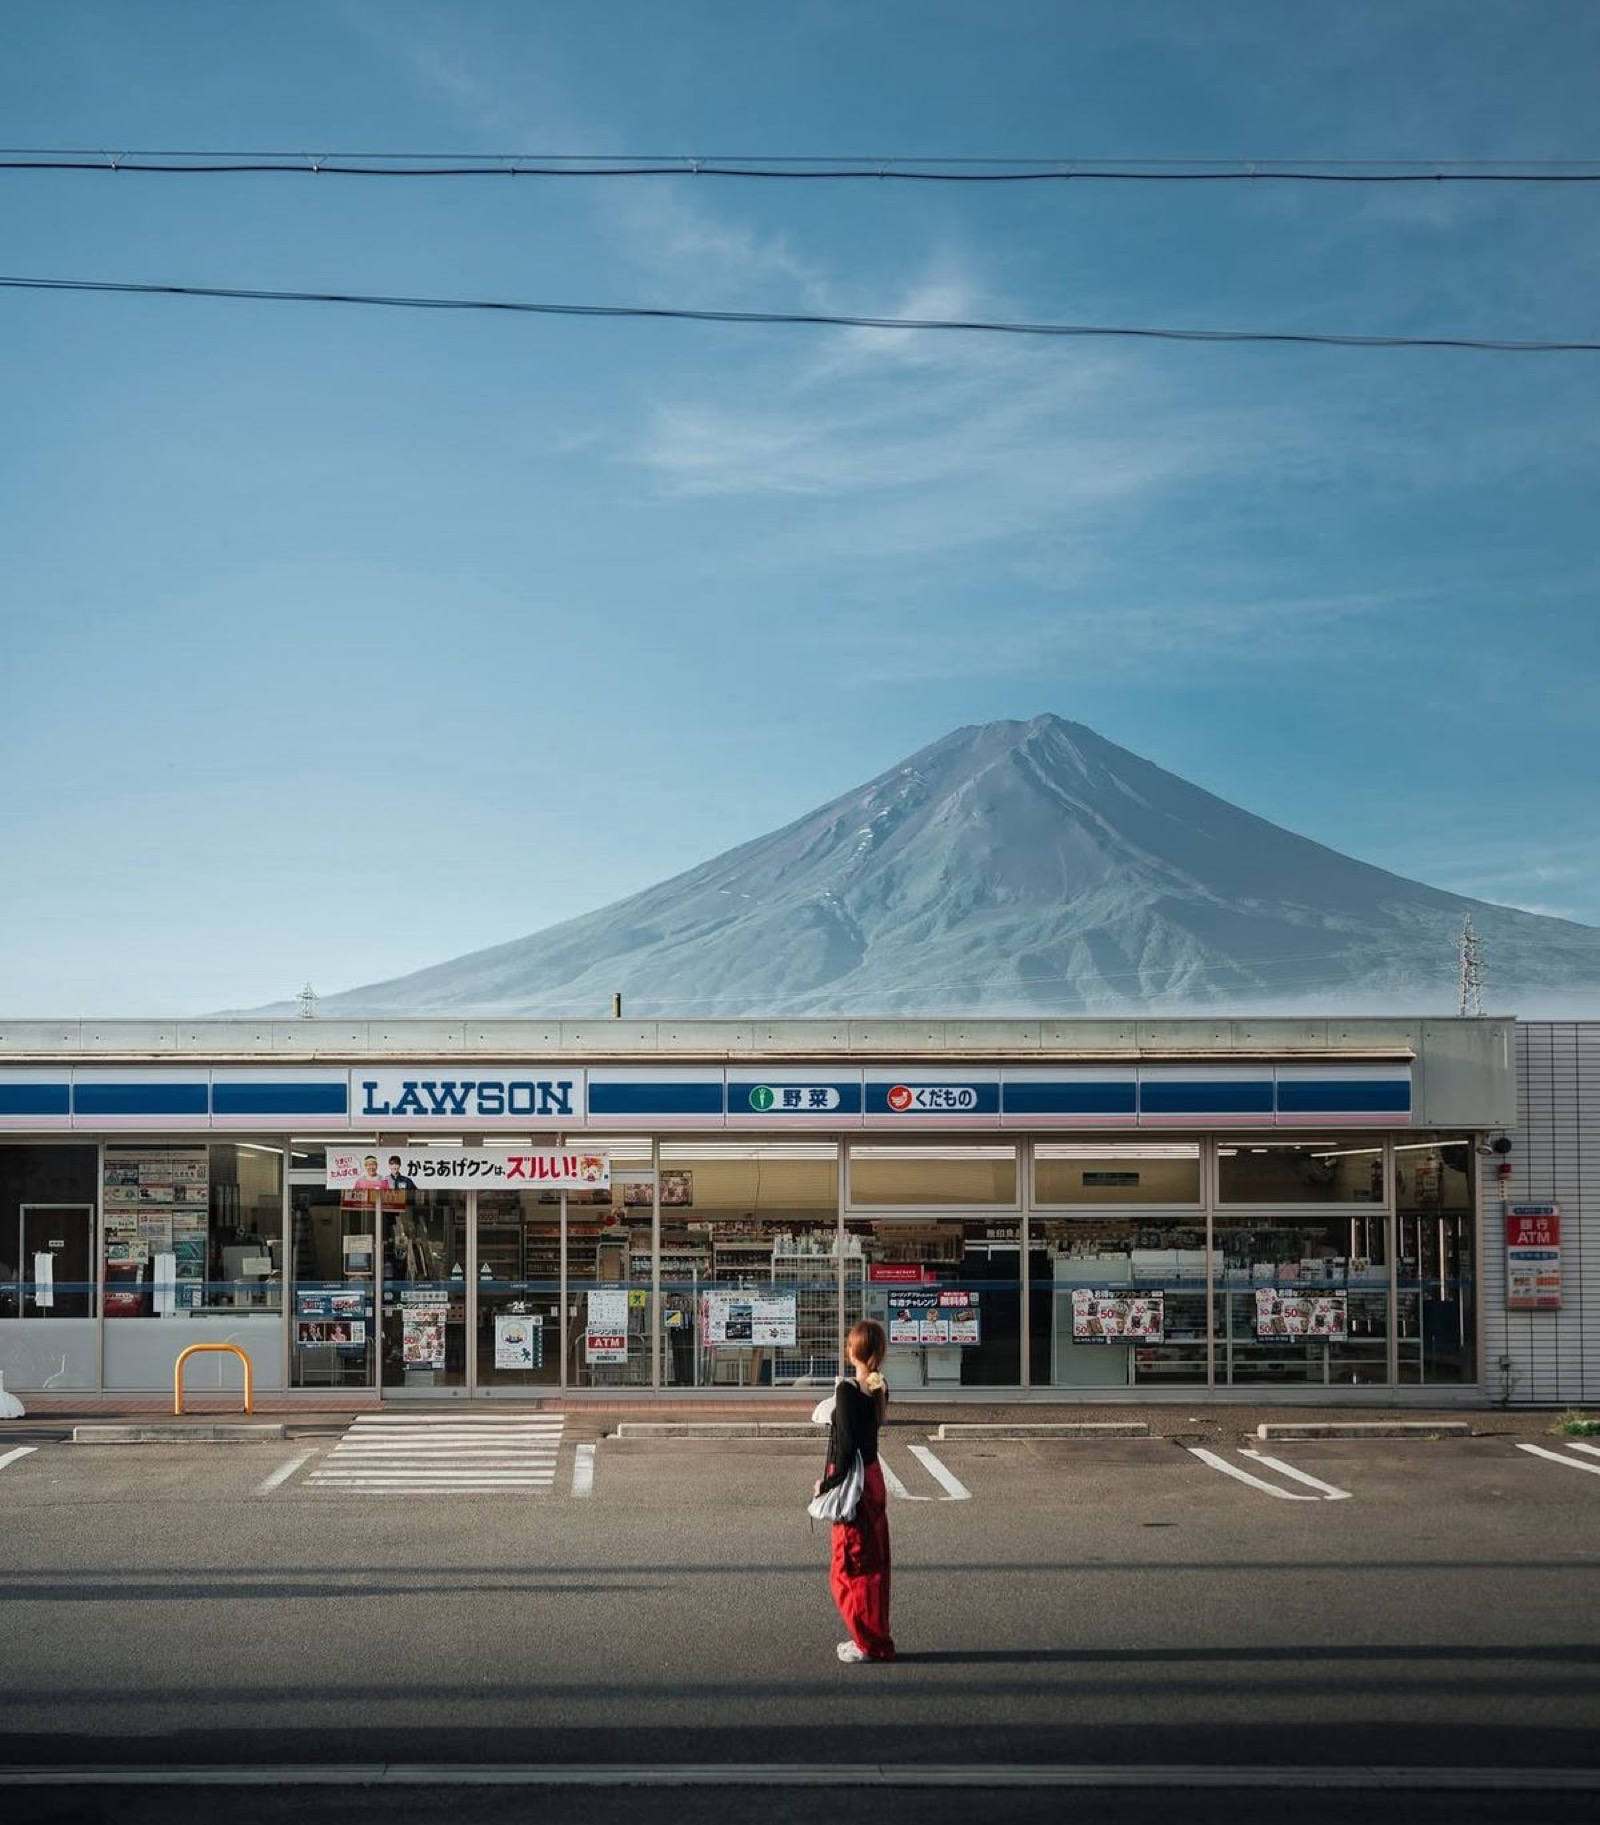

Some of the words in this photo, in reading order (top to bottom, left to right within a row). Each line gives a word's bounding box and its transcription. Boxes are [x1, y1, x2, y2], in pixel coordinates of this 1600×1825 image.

[362, 1081, 573, 1115] LAWSON
[782, 1089, 829, 1108] 野菜
[915, 1088, 972, 1108] くだもの
[1519, 1219, 1548, 1230] 銀行
[1517, 1231, 1550, 1243] ATM
[594, 1338, 620, 1347] ATM
